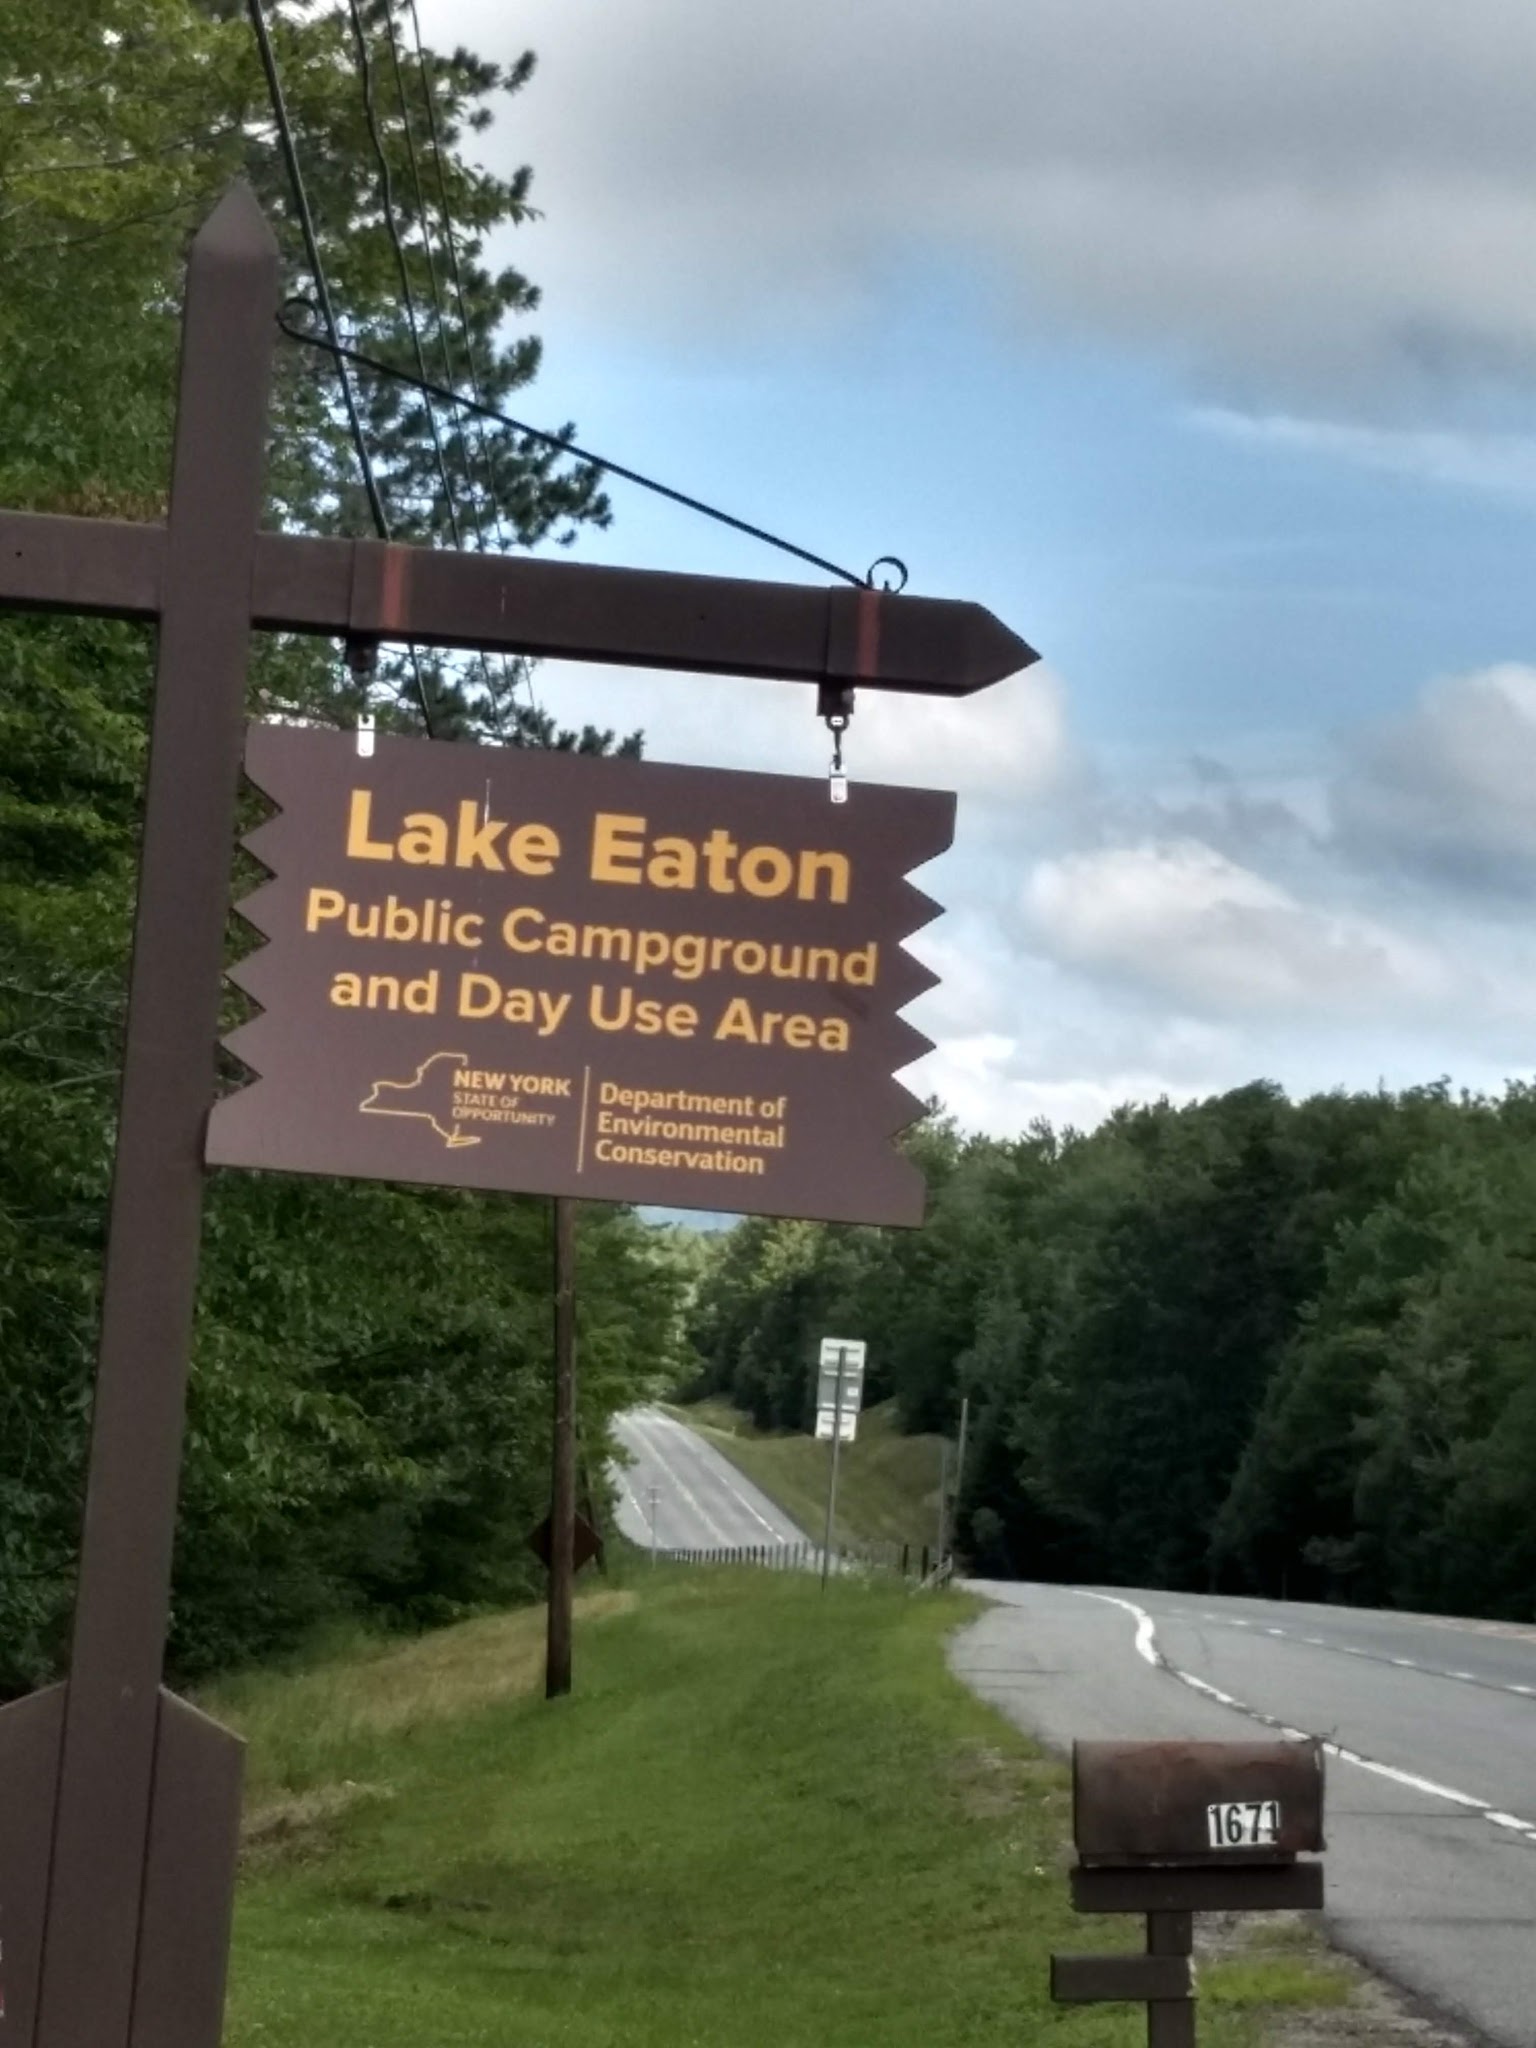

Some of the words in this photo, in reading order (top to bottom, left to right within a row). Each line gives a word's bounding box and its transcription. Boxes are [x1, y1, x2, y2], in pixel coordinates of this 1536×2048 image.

[346, 790, 561, 875] Lake
[590, 812, 852, 904] Eaton
[305, 888, 483, 948] Public
[503, 906, 878, 987] Campground
[330, 970, 439, 1014] and
[459, 971, 571, 1037] Day
[589, 985, 699, 1037] Use
[715, 998, 851, 1053] Area
[453, 1069, 508, 1092] NEW
[509, 1073, 572, 1097] YORK
[453, 1092, 496, 1106] STATE
[498, 1095, 519, 1108] OF
[600, 1083, 755, 1119] Department
[759, 1095, 787, 1118] of
[452, 1106, 556, 1126] OPPORTUNITY
[598, 1112, 786, 1149] Environmental
[595, 1140, 764, 1175] Conservation
[1210, 1802, 1278, 1845] 1671
